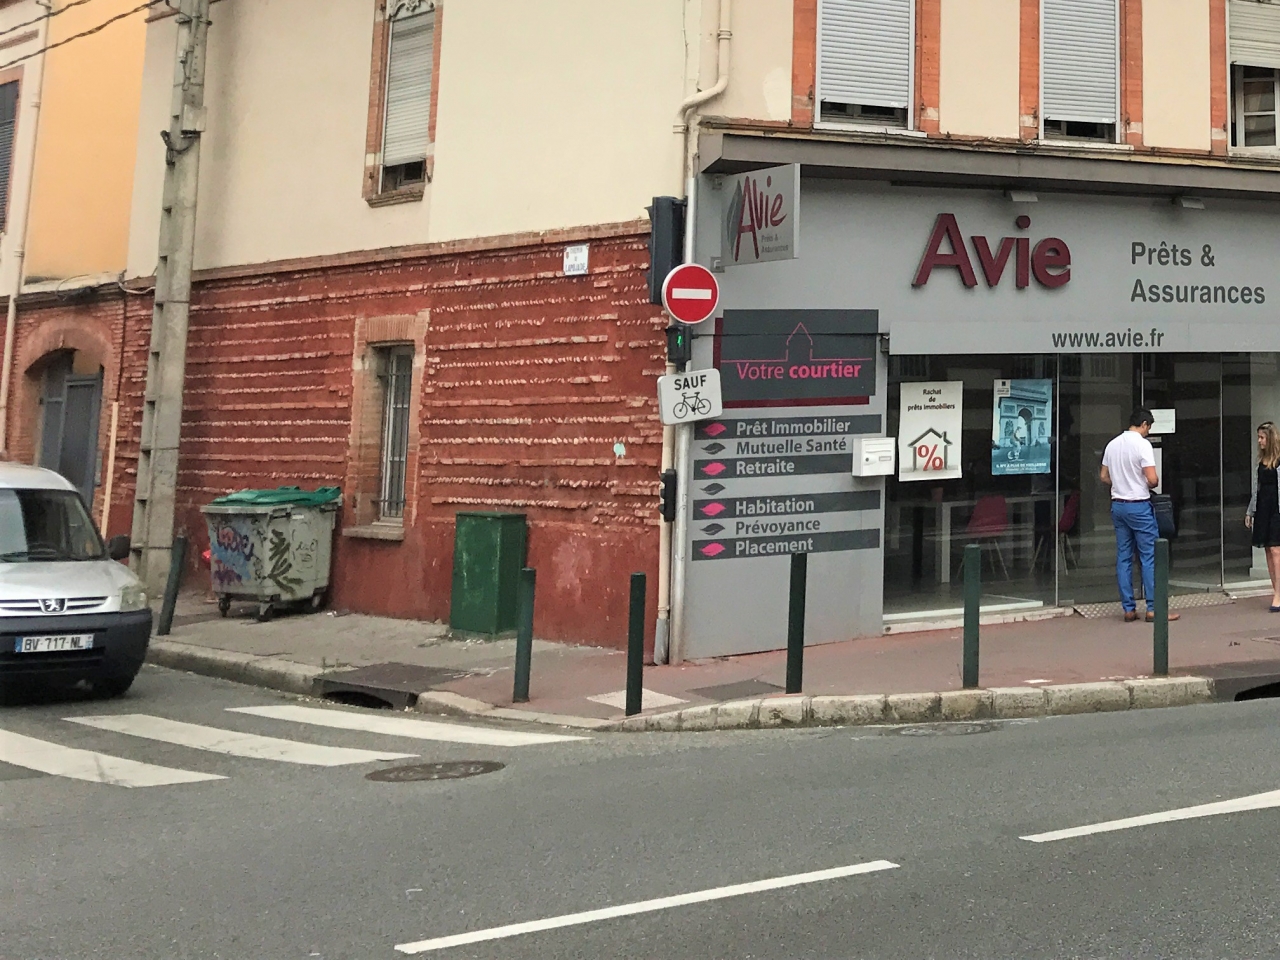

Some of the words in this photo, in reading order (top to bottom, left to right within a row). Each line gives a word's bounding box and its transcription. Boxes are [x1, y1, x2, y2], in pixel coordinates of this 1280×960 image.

[735, 175, 787, 262] Avie
[911, 212, 1072, 289] Avie
[1131, 241, 1192, 267] Prêts
[1200, 244, 1215, 267] &
[1130, 278, 1266, 304] Assurances
[1052, 328, 1164, 348] www.avie.fr
[736, 361, 784, 380] Votre
[789, 361, 861, 379] courtier
[674, 374, 707, 391] SAUF
[922, 388, 942, 396] Rachat
[736, 421, 769, 436] Prêt
[771, 419, 851, 434] Immobilier
[736, 440, 802, 455] Mutuelle
[806, 437, 847, 452] Santé
[736, 460, 795, 475] Retraite
[735, 498, 815, 516] Habitation
[735, 519, 821, 535] Prévoyance
[735, 538, 814, 556] Placement
